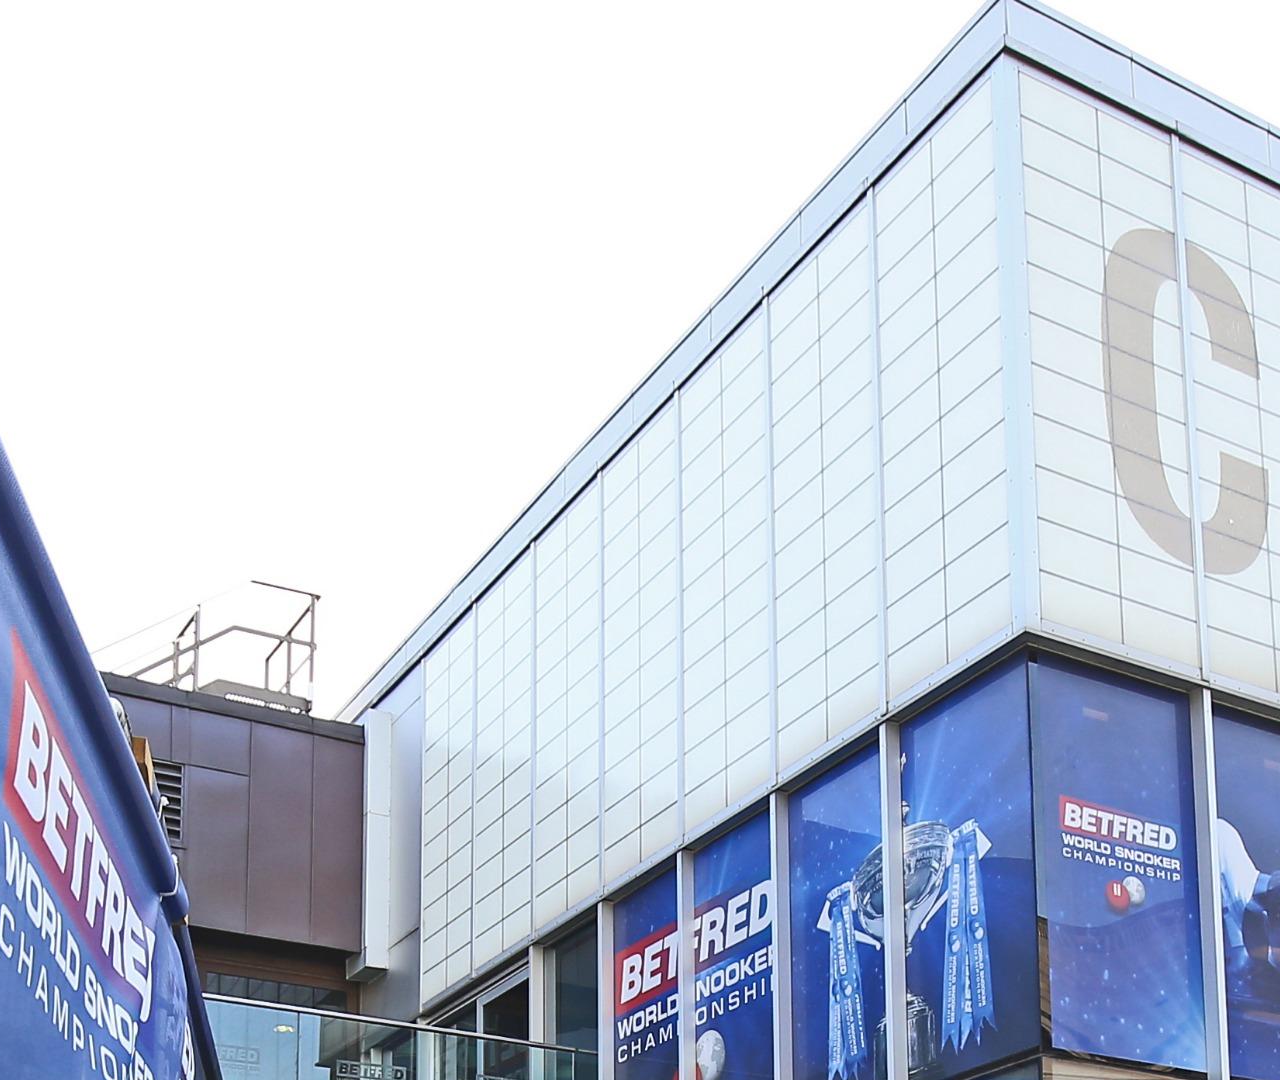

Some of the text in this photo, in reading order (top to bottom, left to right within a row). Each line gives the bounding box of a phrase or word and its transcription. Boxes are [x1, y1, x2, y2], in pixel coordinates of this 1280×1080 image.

[1064, 802, 1177, 851] BETFRED
[1061, 832, 1181, 871] WORLD SNOOKER
[1062, 847, 1181, 882] CHAMPIONSHIP
[3, 820, 81, 992] WORLD
[968, 854, 979, 916] BETFRED
[836, 922, 847, 976] BETFRED
[617, 993, 679, 1040] WORLD
[338, 1062, 405, 1080] BETFRED
